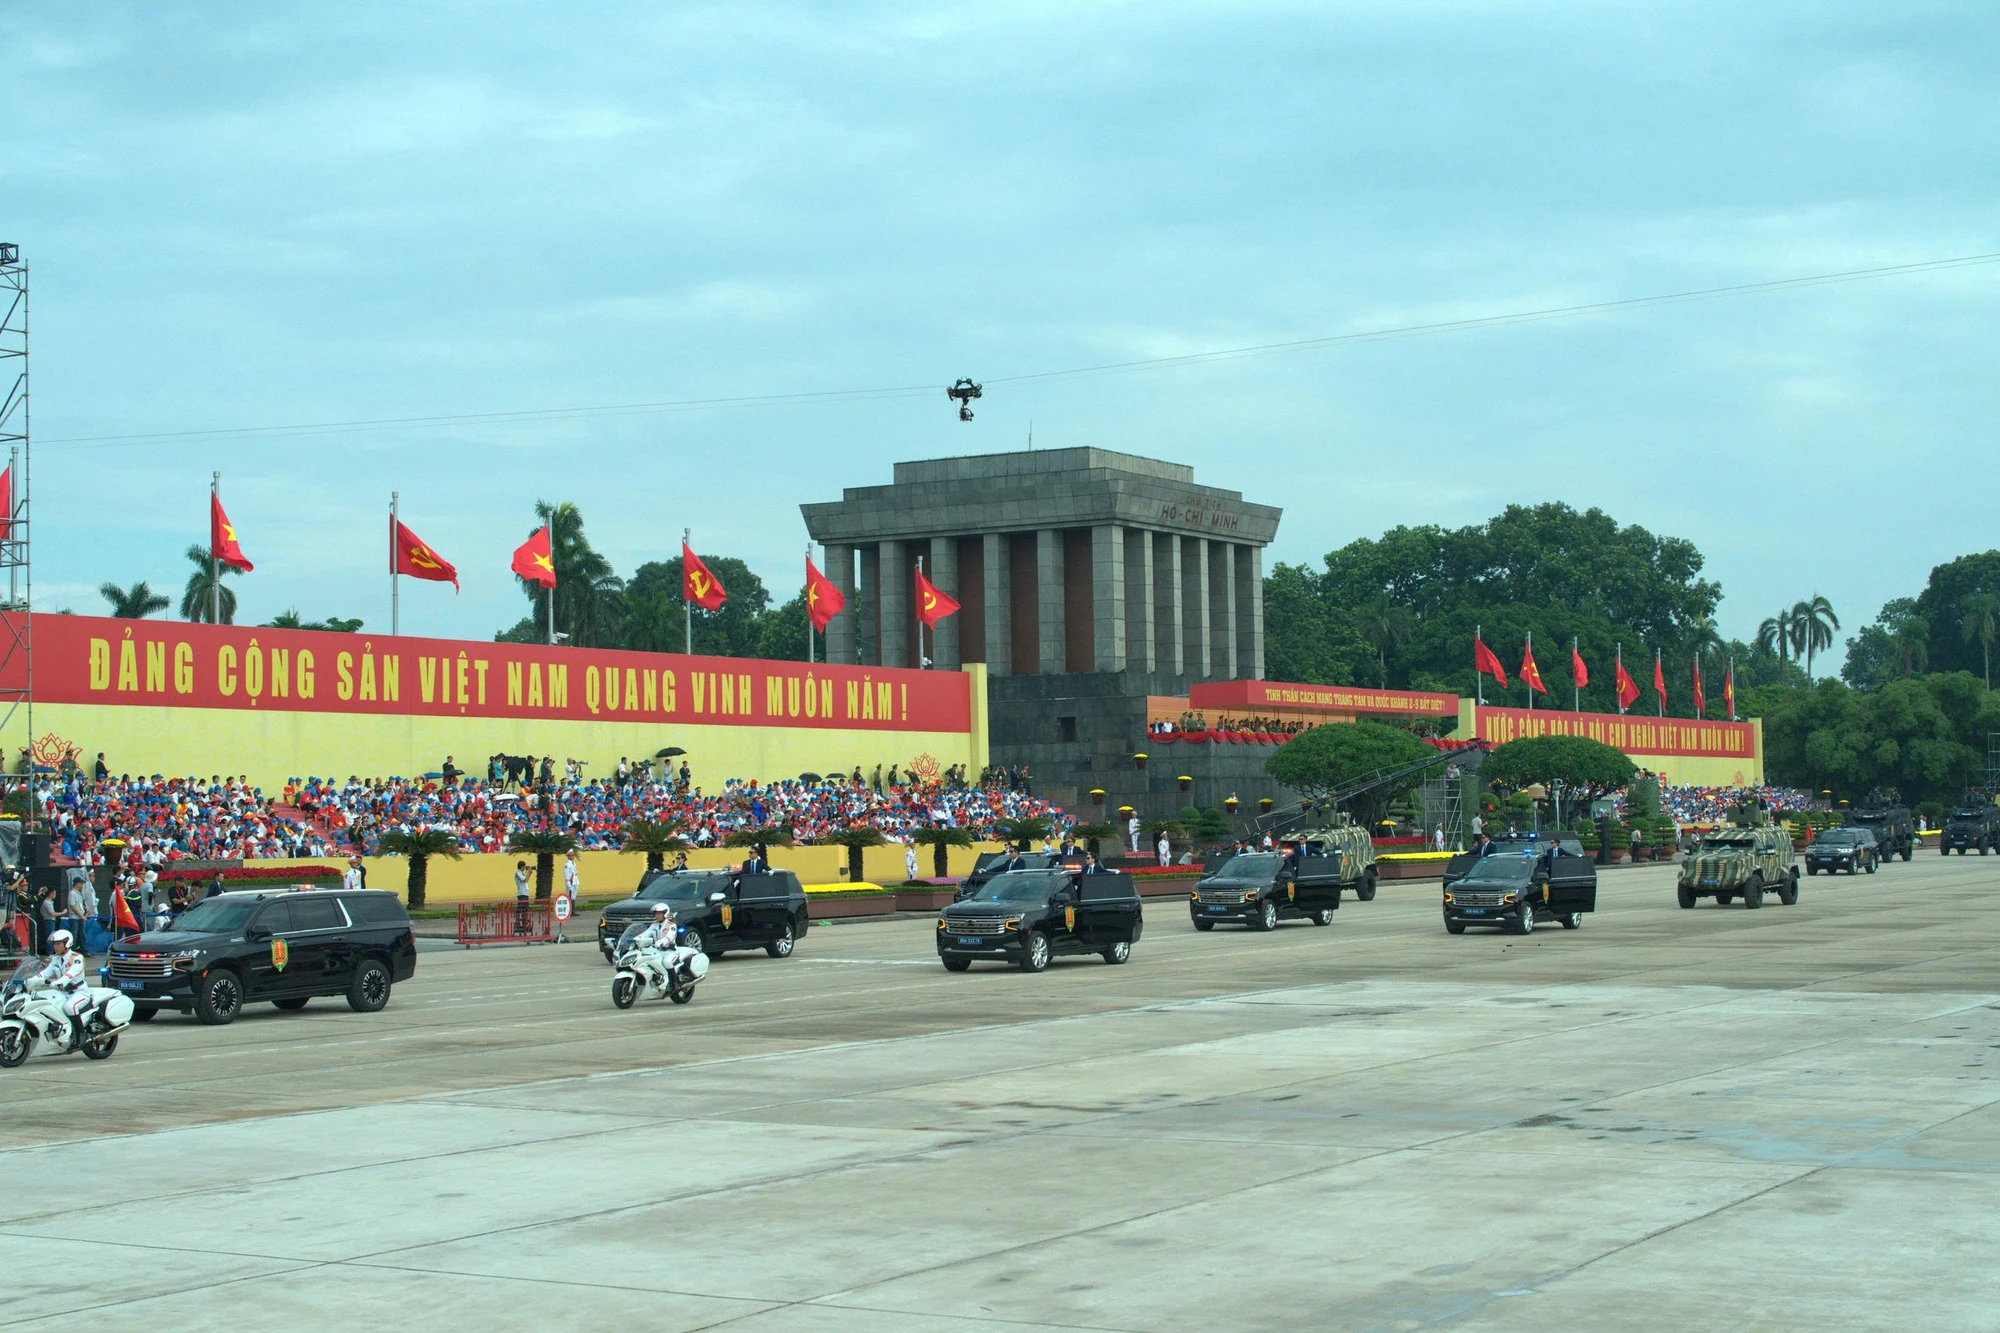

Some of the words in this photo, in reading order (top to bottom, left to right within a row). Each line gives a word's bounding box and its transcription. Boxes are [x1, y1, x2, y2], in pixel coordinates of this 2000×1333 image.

[89, 627, 193, 694] ĐẢNG
[218, 638, 315, 706] CỘNG
[337, 641, 399, 701] SẢN
[419, 650, 489, 713] VIỆT
[507, 661, 568, 708] NAM
[585, 665, 676, 714] QUANG
[691, 672, 752, 715] VINH
[766, 671, 833, 718] MUÔN
[1265, 688, 1281, 702] TINH
[1486, 712, 1514, 743] NƯỚC
[1630, 721, 1657, 748] NGHĨA
[1660, 722, 1677, 753] VIỆT
[1680, 726, 1697, 750] NAM
[1701, 724, 1721, 751] MUÔN
